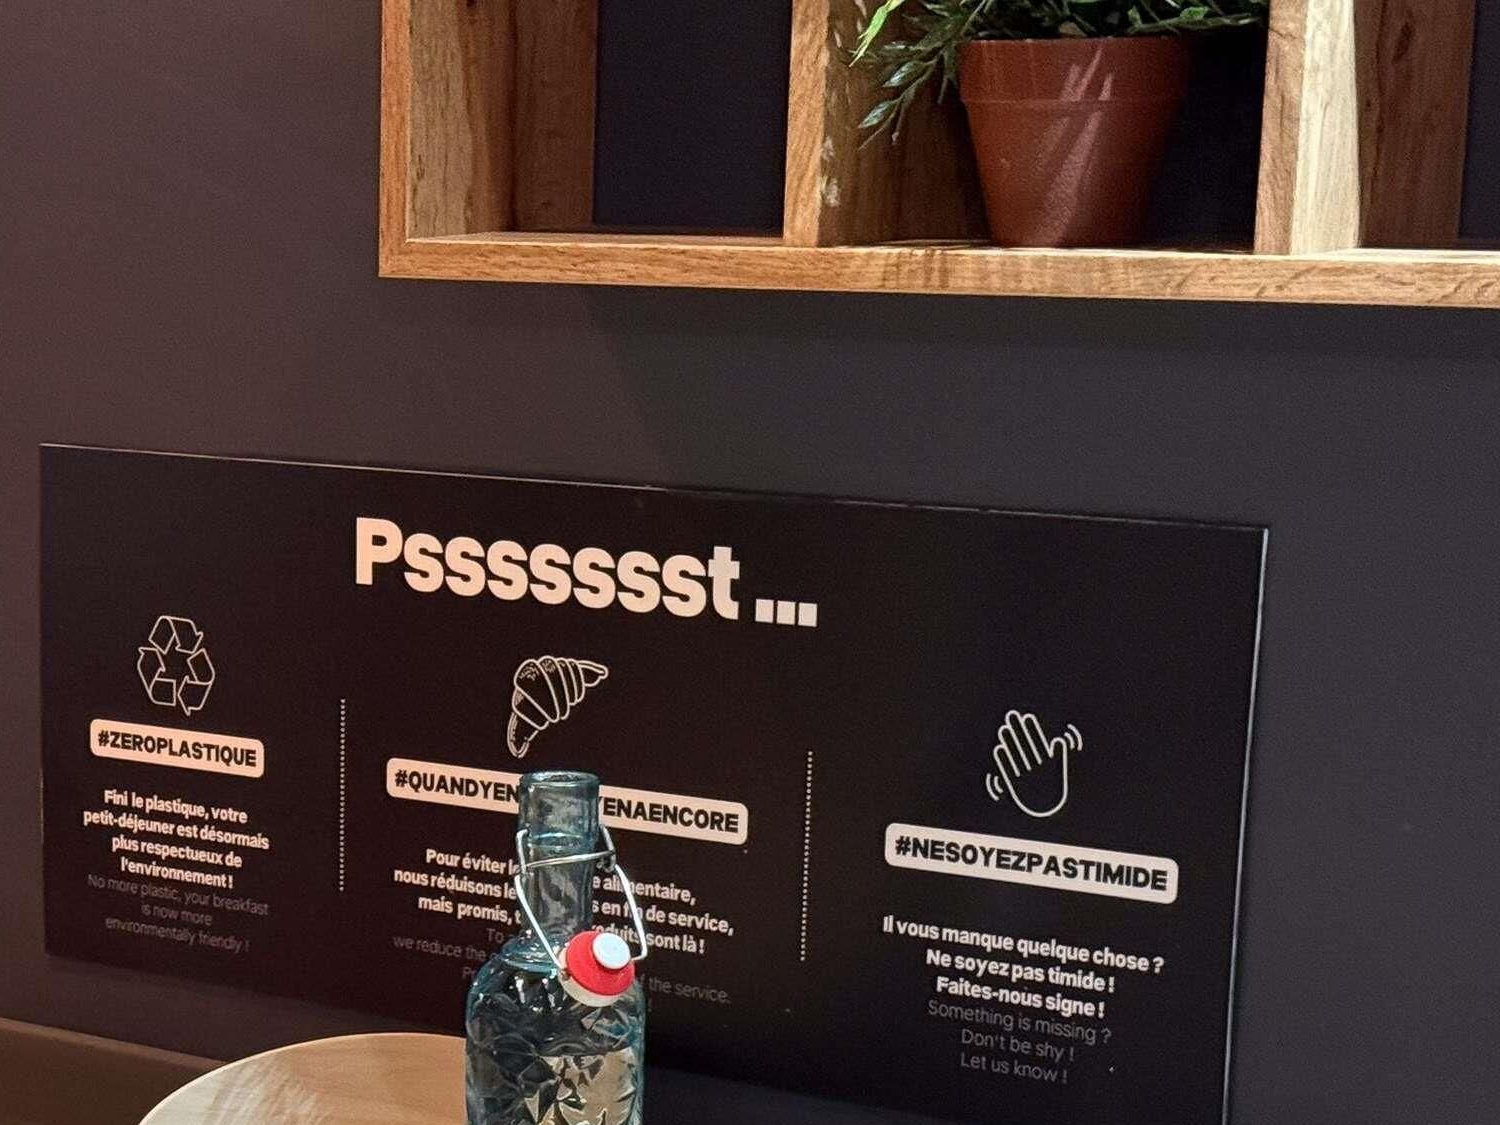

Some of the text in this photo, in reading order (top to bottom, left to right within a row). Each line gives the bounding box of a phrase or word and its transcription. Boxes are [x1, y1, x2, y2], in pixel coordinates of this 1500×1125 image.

[355, 517, 741, 621] Pssssssst
[98, 731, 256, 767] #ZEROPLASTIQUE
[104, 789, 247, 823] Fini le plastique, votre
[84, 811, 269, 849] petit-déjeuner est désormais
[112, 835, 242, 867] plus respectueux de
[426, 849, 459, 866] Pour
[462, 853, 506, 874] éviter
[896, 836, 1168, 891] #NESOYEZPASTIMIDE
[88, 874, 269, 915] No more plastic, your breakfast
[141, 903, 212, 925] is now more
[394, 869, 428, 886] nous
[431, 872, 501, 897] réduisons
[601, 902, 621, 917] en
[646, 905, 665, 922] de
[668, 912, 734, 937] service,
[105, 917, 196, 945] environmentally
[418, 896, 453, 913] mais
[458, 903, 512, 925] promis,
[646, 933, 680, 950] sont
[683, 934, 697, 953] là
[487, 928, 504, 943] To
[883, 915, 894, 934] Il
[896, 921, 940, 940] vous
[942, 928, 1014, 951] manque
[1017, 939, 1090, 963] quelque
[1093, 947, 1150, 971] chose
[393, 937, 412, 949] we
[416, 939, 462, 957] reduce
[467, 945, 486, 960] the
[649, 976, 672, 993] the
[675, 983, 731, 1004] service.
[926, 949, 951, 967] Ne
[955, 955, 1009, 977] soyez
[1012, 963, 1045, 983] pas
[1048, 967, 1105, 992] timide
[936, 976, 1042, 1008] Faites-nous
[1046, 993, 1095, 1018] signe
[928, 1000, 1014, 1031] Something
[1018, 1013, 1030, 1030] is
[1035, 1019, 1096, 1045] missing
[961, 1029, 1006, 1047] Don't
[1010, 1035, 1031, 1055] be
[1035, 1041, 1064, 1063] shy
[960, 1052, 987, 1070] Let
[991, 1058, 1009, 1073] us
[1014, 1060, 1058, 1082] know
